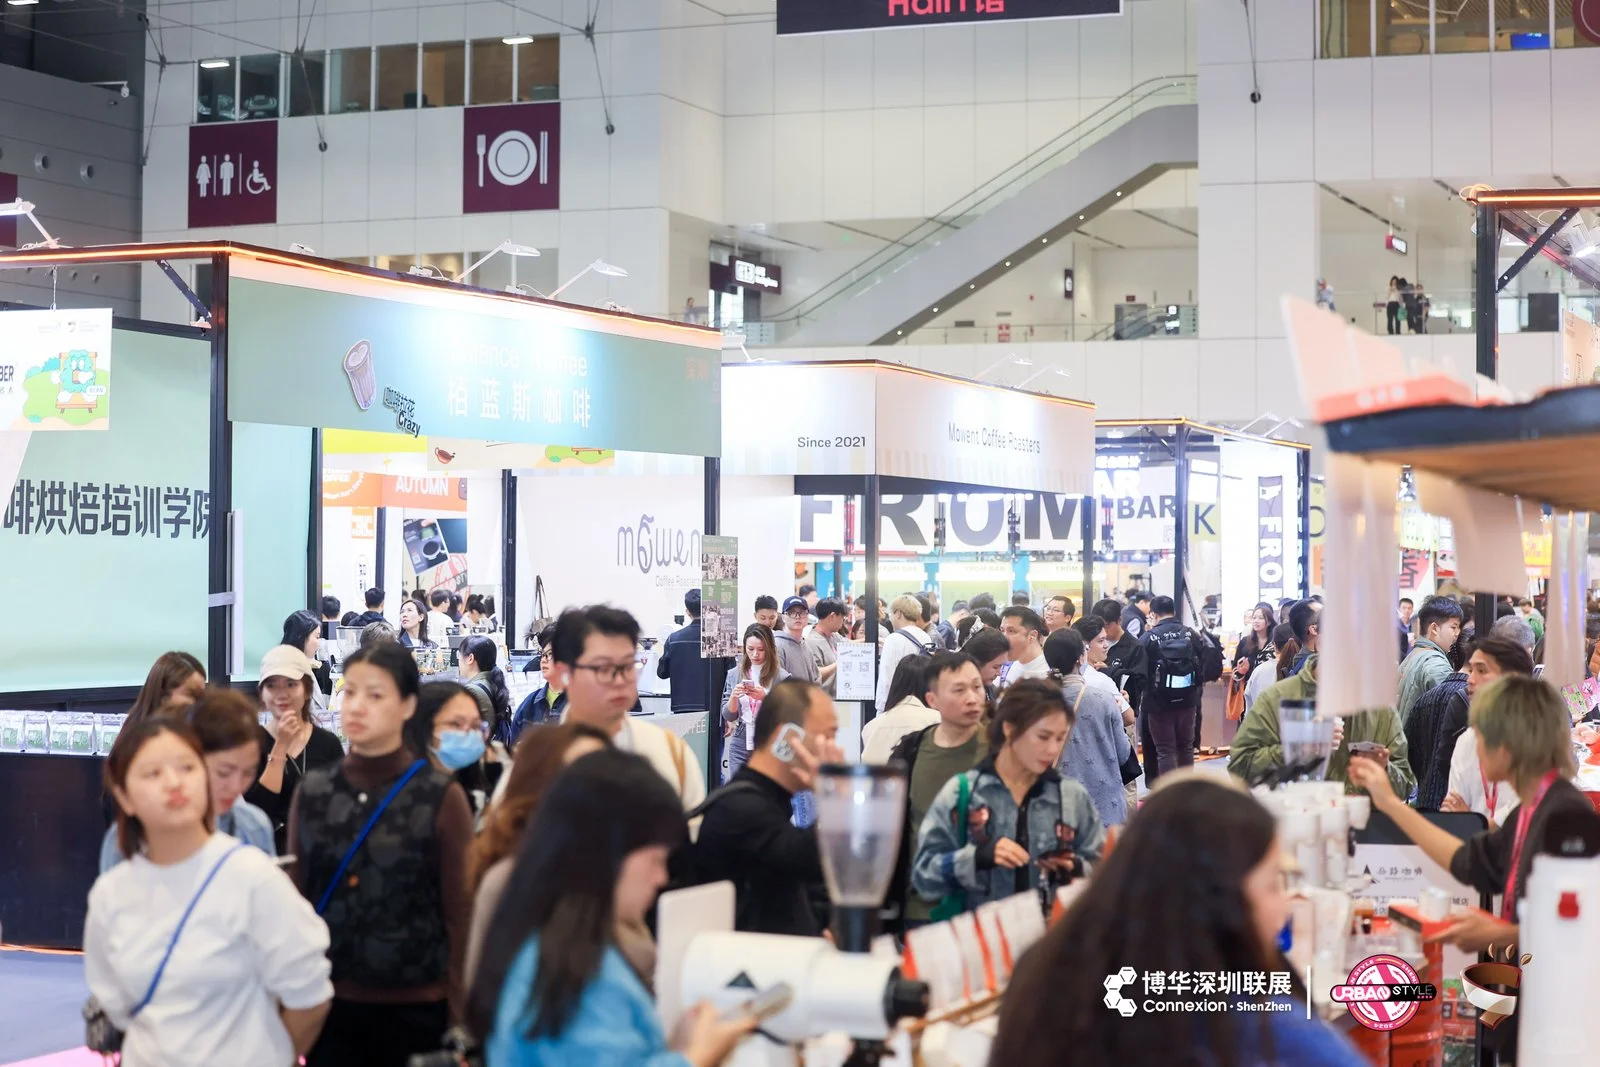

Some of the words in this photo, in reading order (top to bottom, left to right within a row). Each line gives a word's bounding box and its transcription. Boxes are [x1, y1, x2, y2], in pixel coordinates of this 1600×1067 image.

[398, 410, 421, 438] Crazy
[797, 436, 832, 448] Since
[835, 436, 866, 448] 2021
[948, 422, 979, 445] Mowent
[981, 427, 1007, 449] Coffee
[1008, 432, 1041, 453] Roasters
[395, 475, 450, 497] AUTUMN
[1117, 494, 1176, 519] BAR
